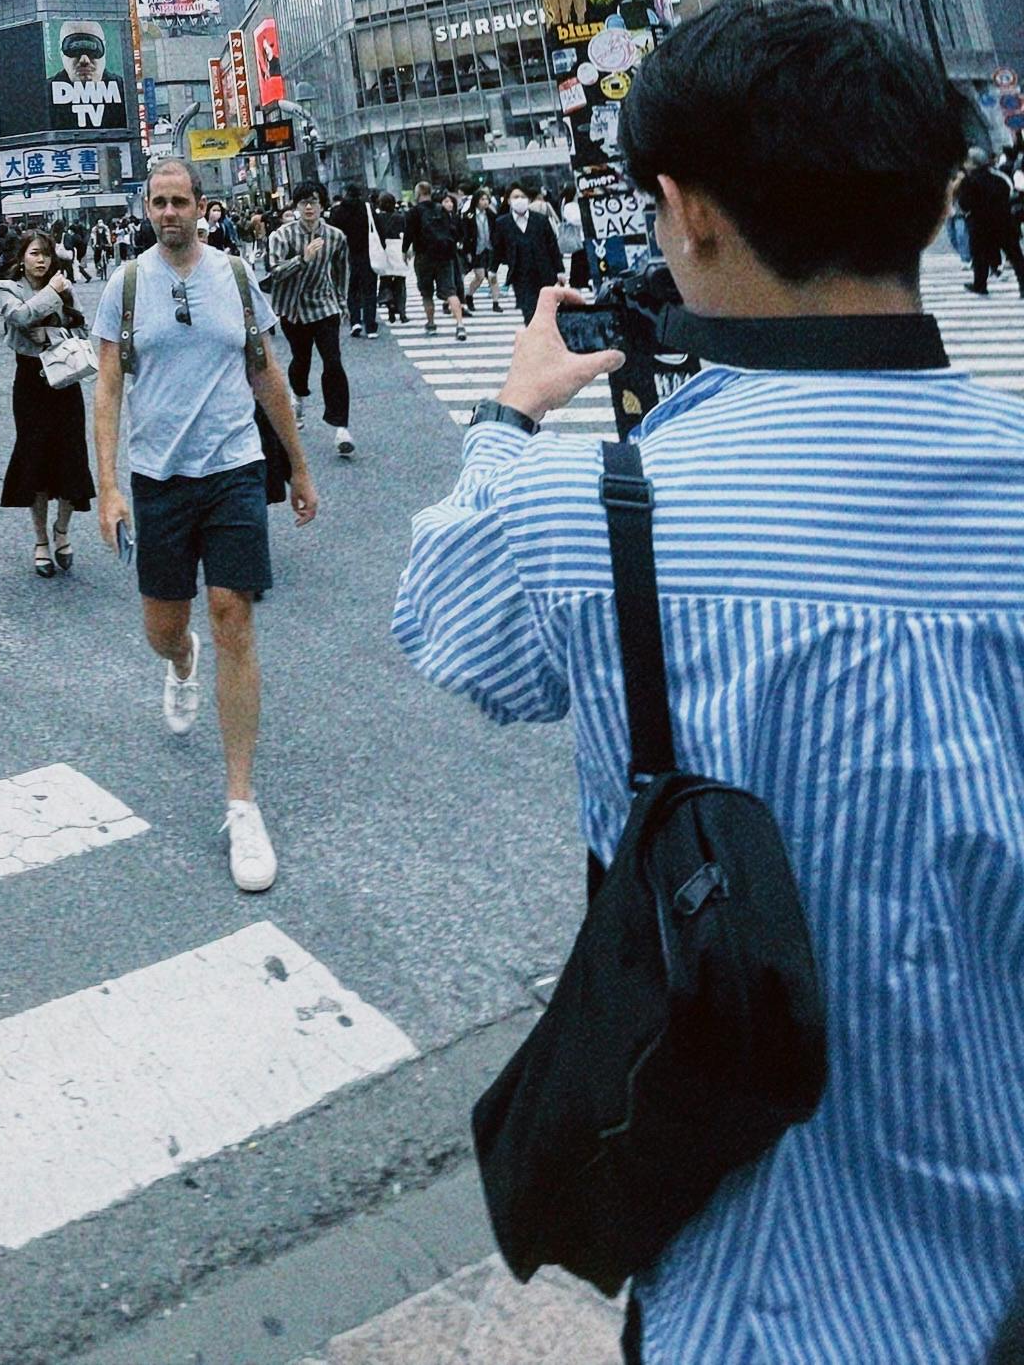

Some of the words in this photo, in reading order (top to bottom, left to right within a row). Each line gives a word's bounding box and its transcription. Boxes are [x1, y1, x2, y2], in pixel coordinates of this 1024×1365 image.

[51, 80, 122, 105] DMM
[72, 104, 105, 128] TV
[4, 149, 98, 180] 大盛堂書
